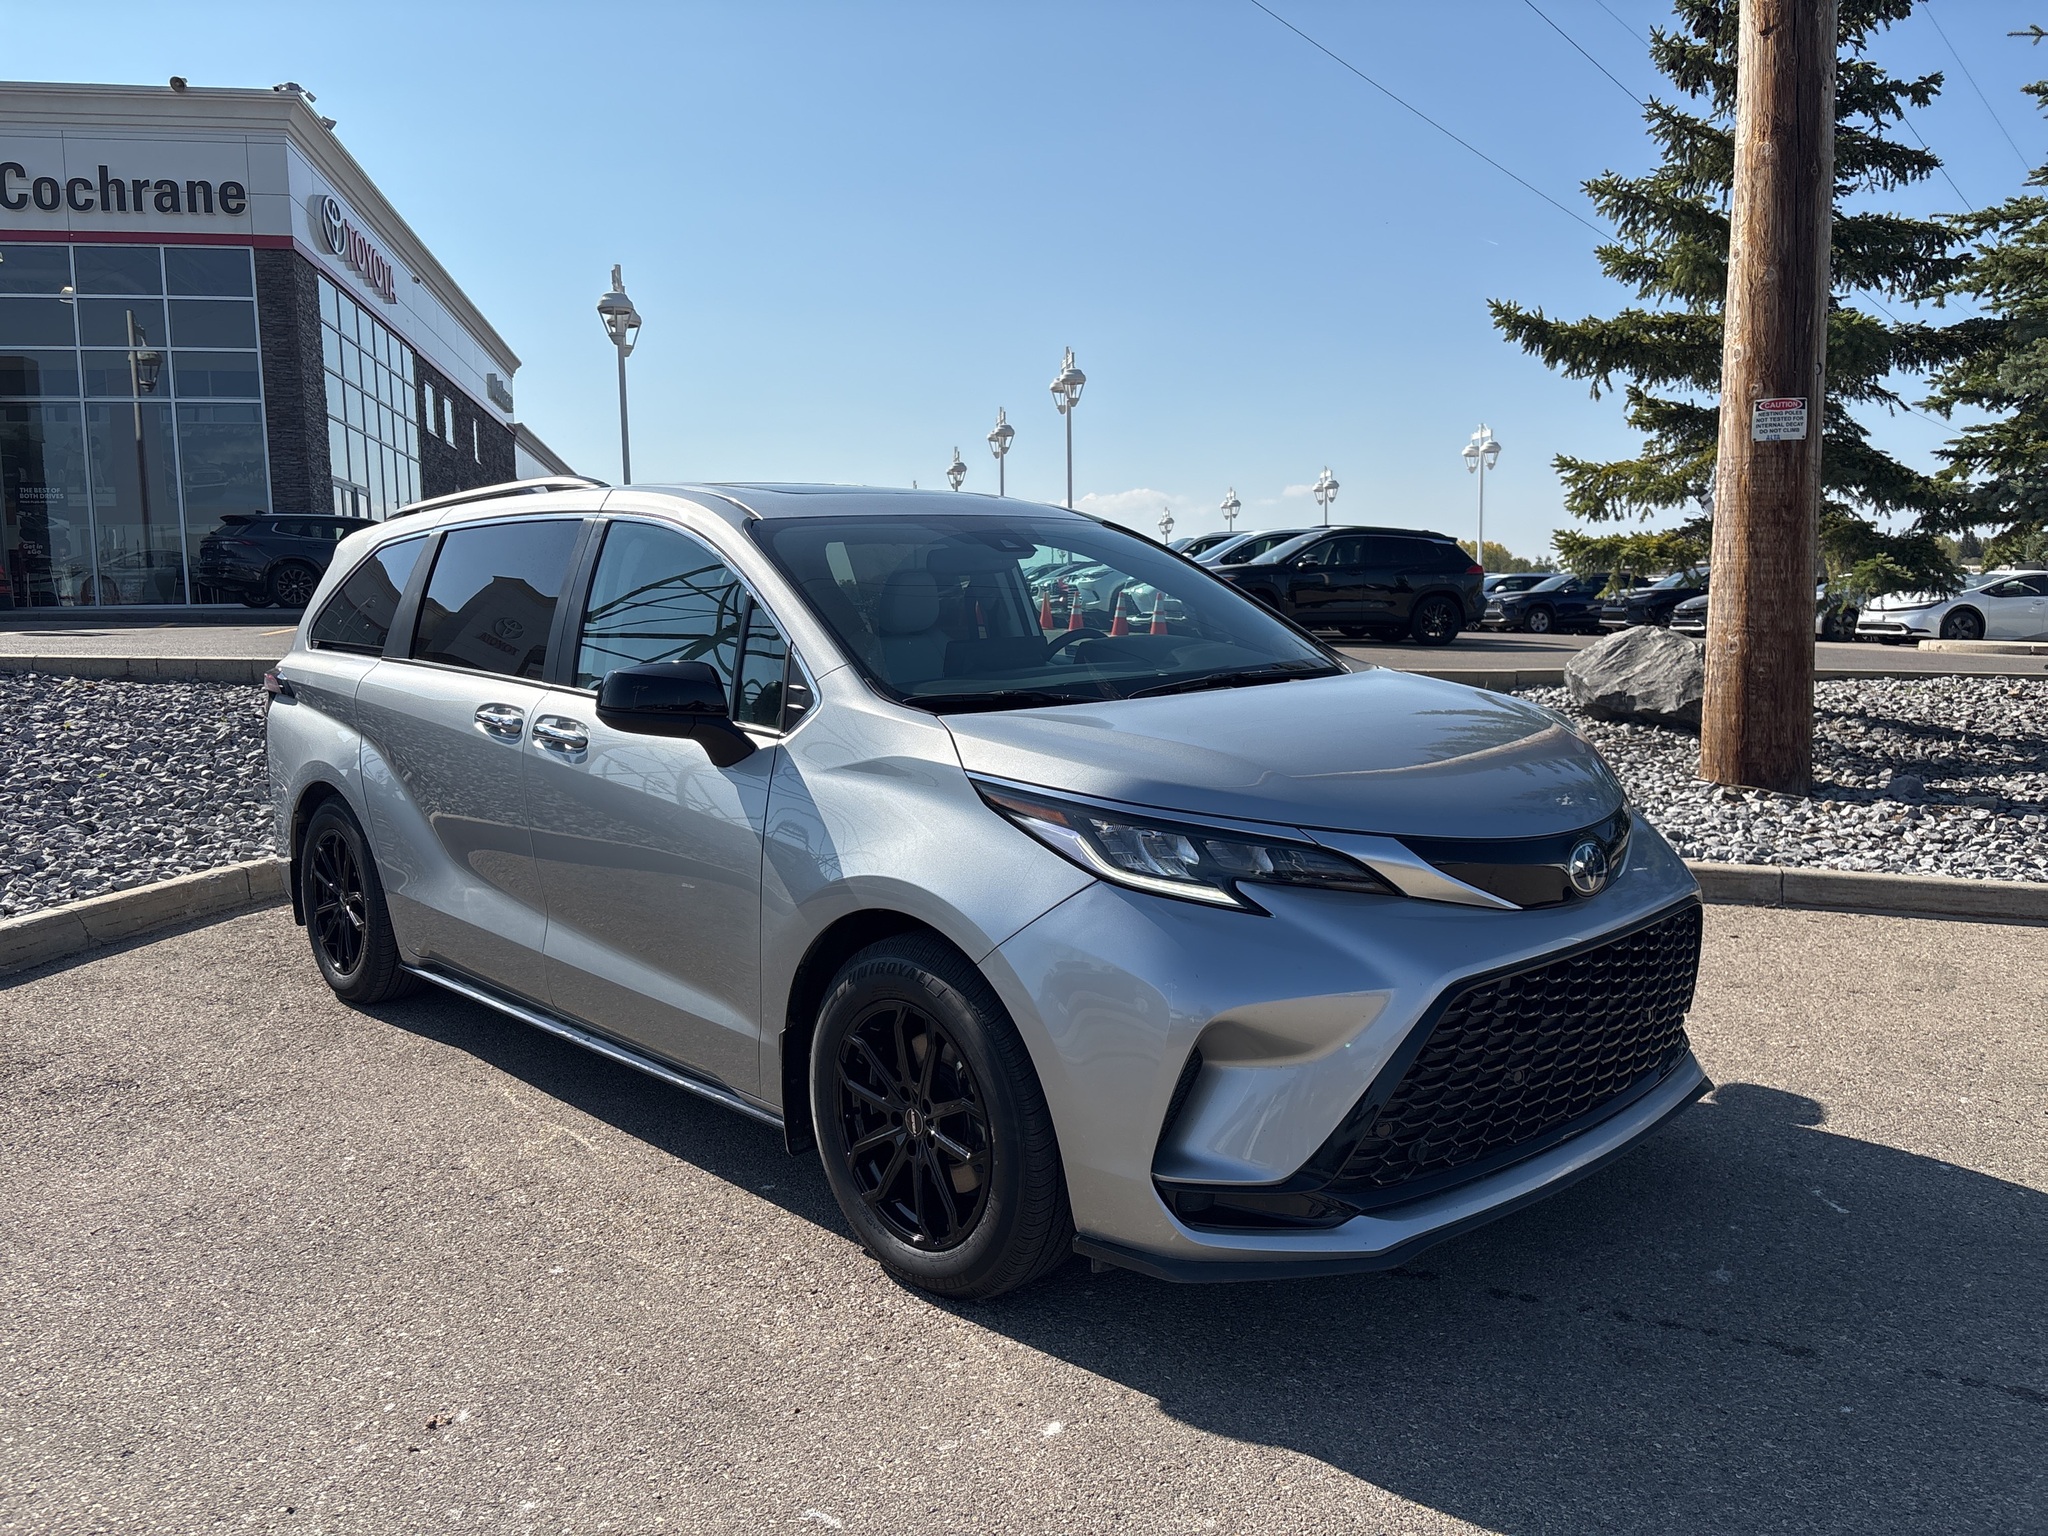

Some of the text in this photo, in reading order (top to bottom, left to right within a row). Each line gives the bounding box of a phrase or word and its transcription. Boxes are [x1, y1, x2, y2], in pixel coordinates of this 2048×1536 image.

[0, 161, 247, 214] Cochrane
[345, 219, 397, 304] TOYOTA
[847, 961, 927, 987] UNIROYAL
